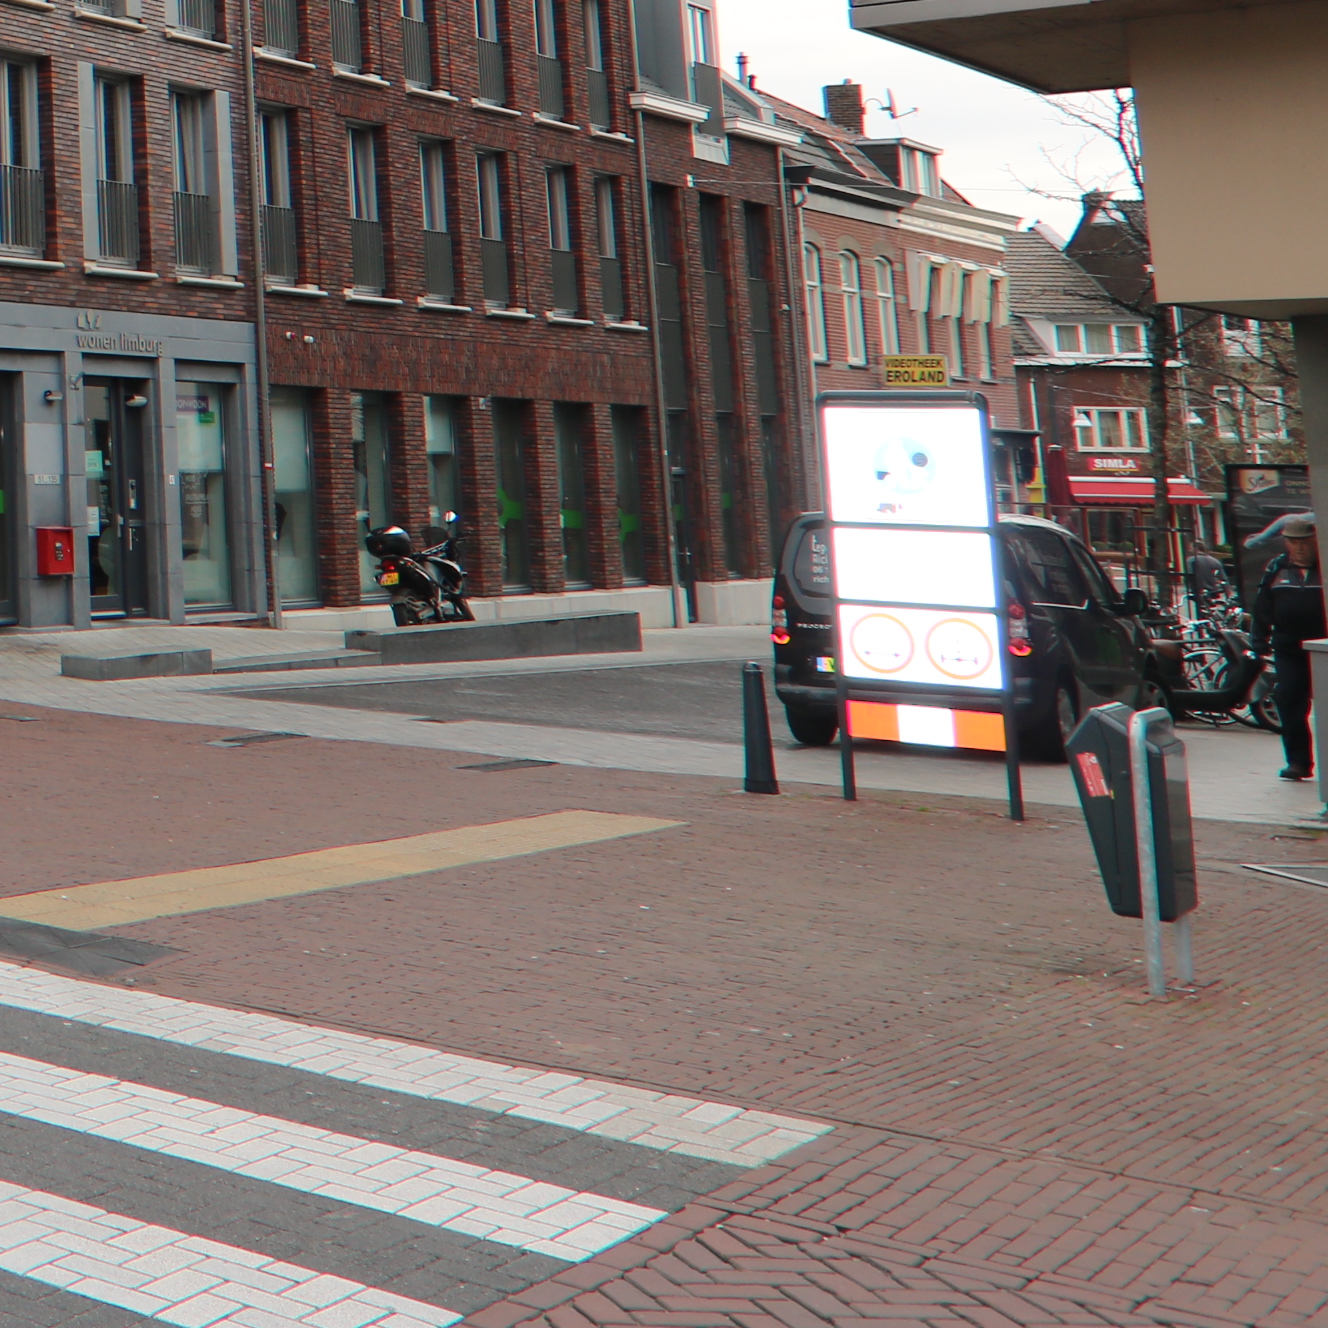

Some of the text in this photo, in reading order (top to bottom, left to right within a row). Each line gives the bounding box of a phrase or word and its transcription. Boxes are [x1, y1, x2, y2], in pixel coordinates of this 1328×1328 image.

[77, 332, 164, 357] wonen limburg
[886, 358, 944, 368] VIDEOTHEEK
[886, 370, 944, 383] EROLAND
[1094, 458, 1137, 469] SIMLA
